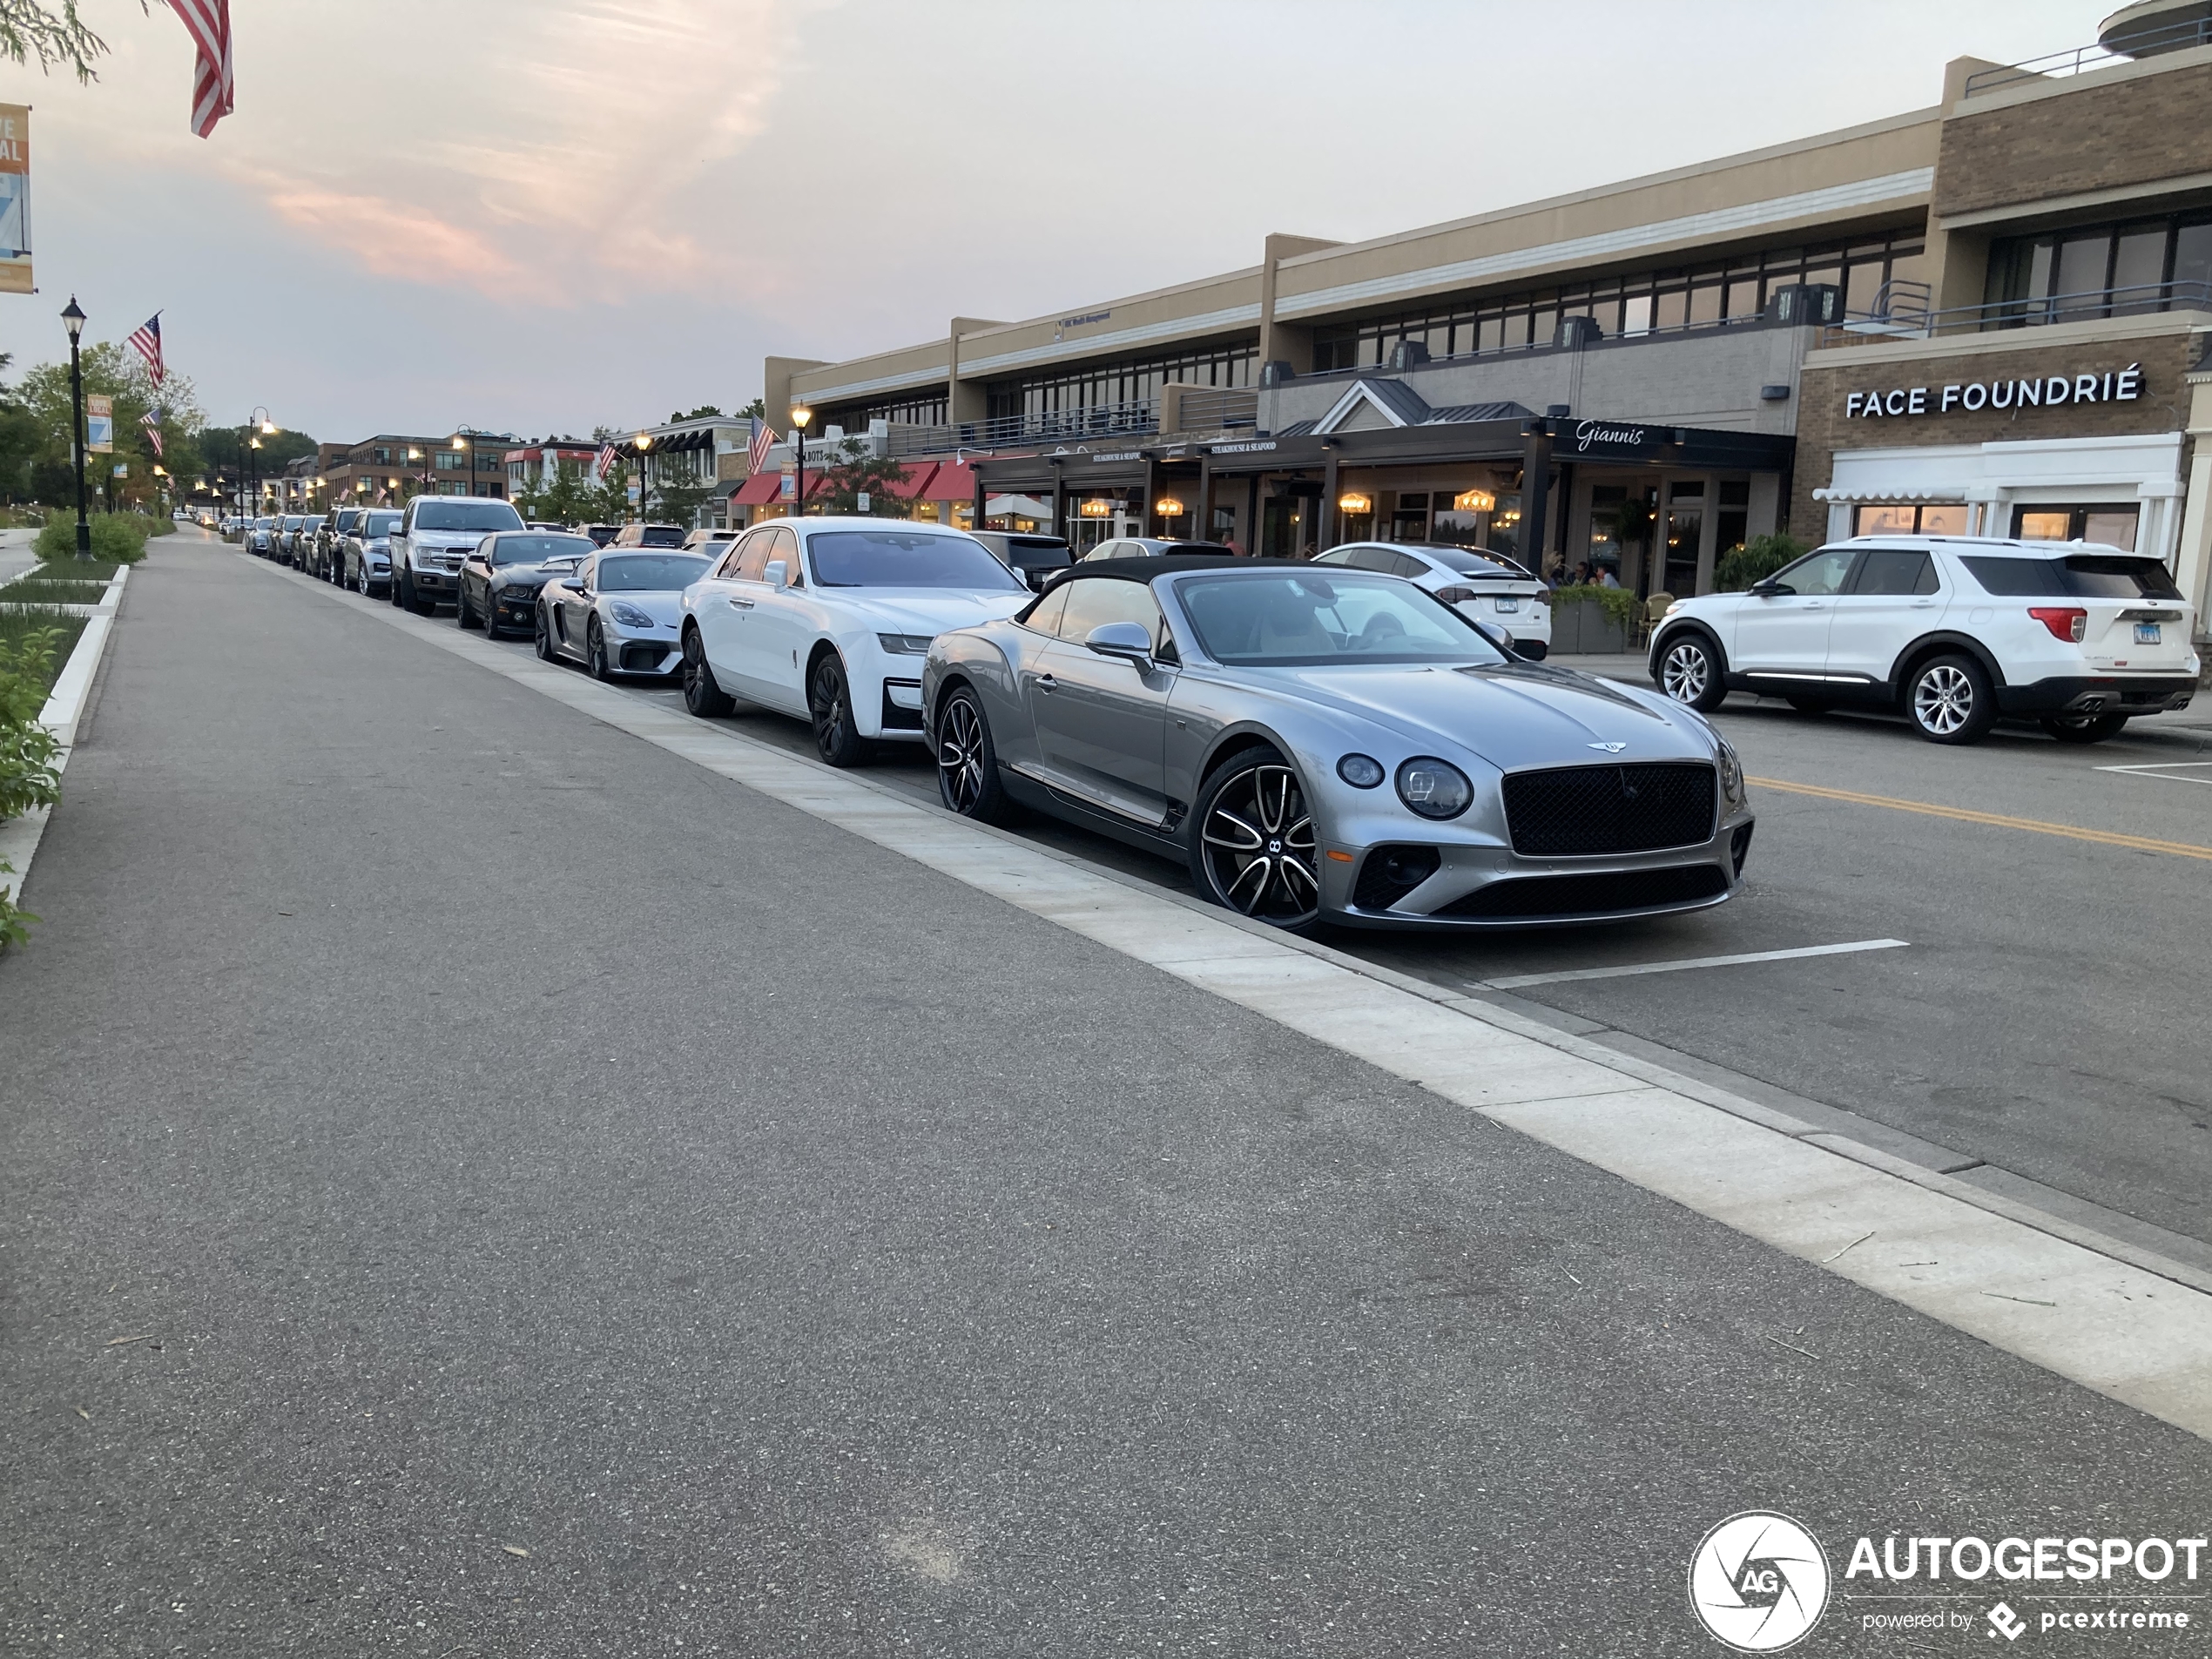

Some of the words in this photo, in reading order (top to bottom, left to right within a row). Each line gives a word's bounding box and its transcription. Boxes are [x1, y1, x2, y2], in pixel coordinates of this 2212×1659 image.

[1846, 388, 1927, 418] FACE
[1941, 362, 2140, 412] FOUNDRIÉ
[90, 406, 110, 415] LOCAL
[1576, 418, 1644, 452] Giannis
[1211, 443, 1245, 455] STEAKHOUSE
[1251, 442, 1277, 451] SEAFOOD
